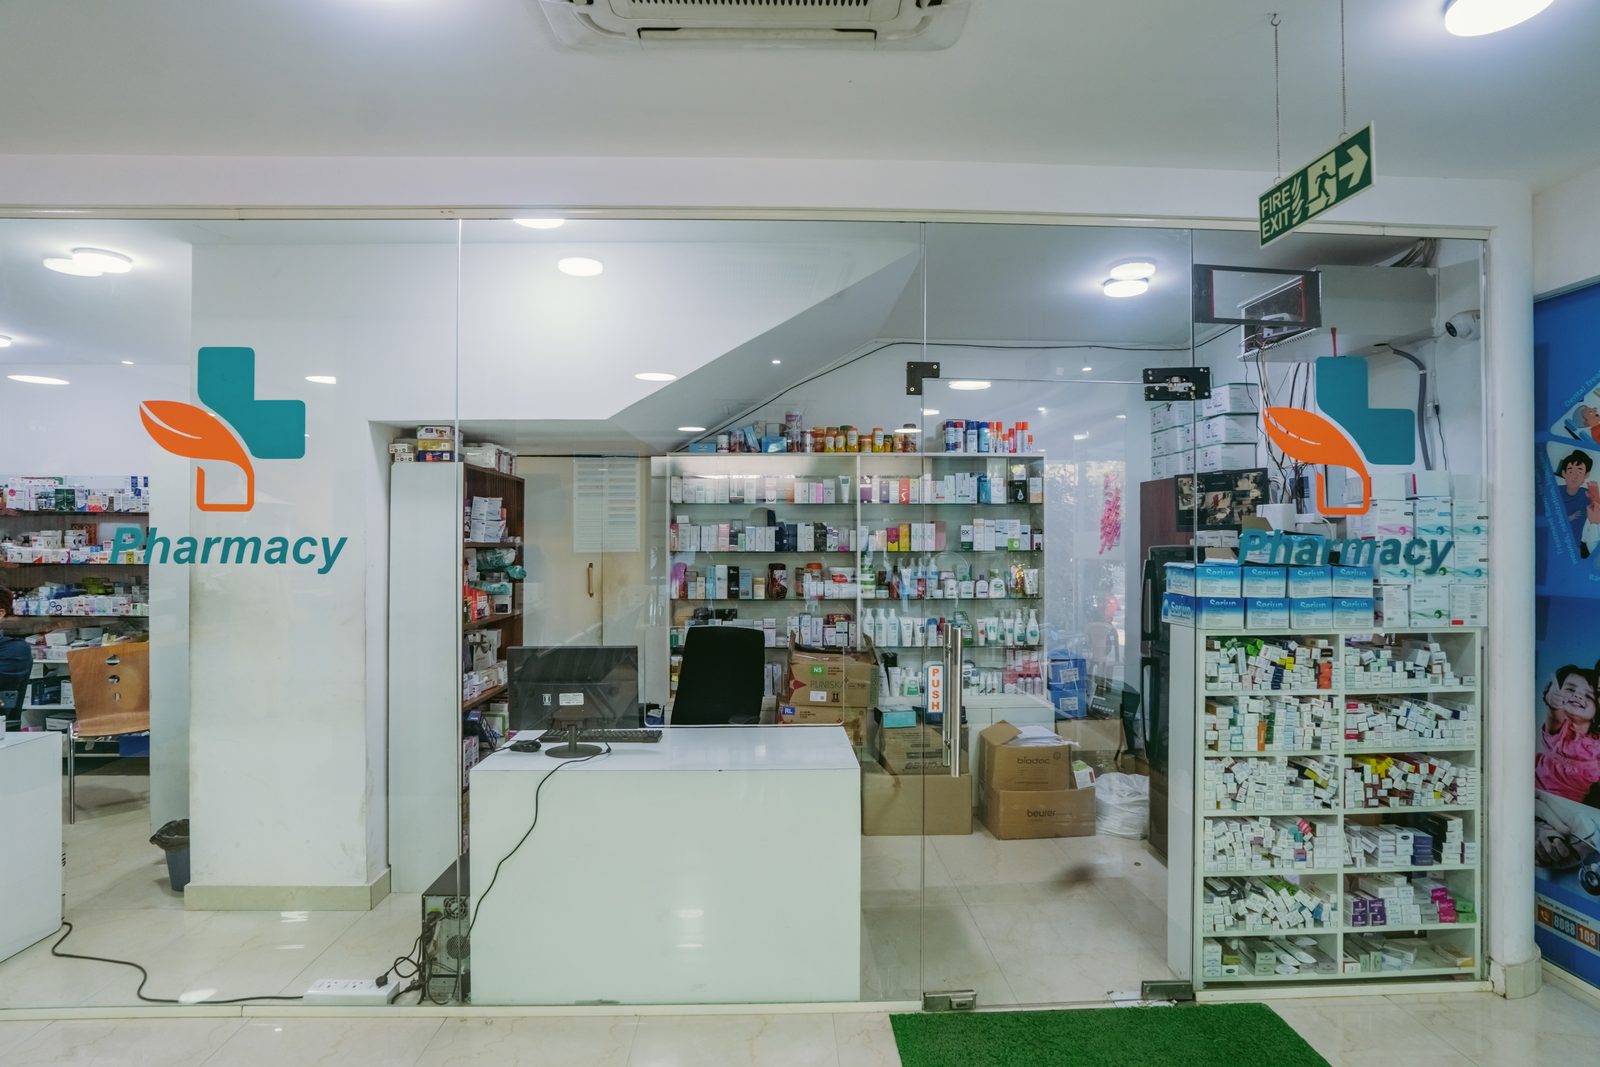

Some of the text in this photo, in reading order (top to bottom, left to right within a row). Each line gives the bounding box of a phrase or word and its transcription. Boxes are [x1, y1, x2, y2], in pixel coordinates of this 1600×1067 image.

[1261, 184, 1290, 218] FIRE
[1262, 207, 1290, 239] EXIT
[110, 527, 348, 575] Pharmacy
[1238, 528, 1455, 575] Pharmacy
[931, 668, 941, 711] PUSH
[1578, 926, 1597, 947] 108
